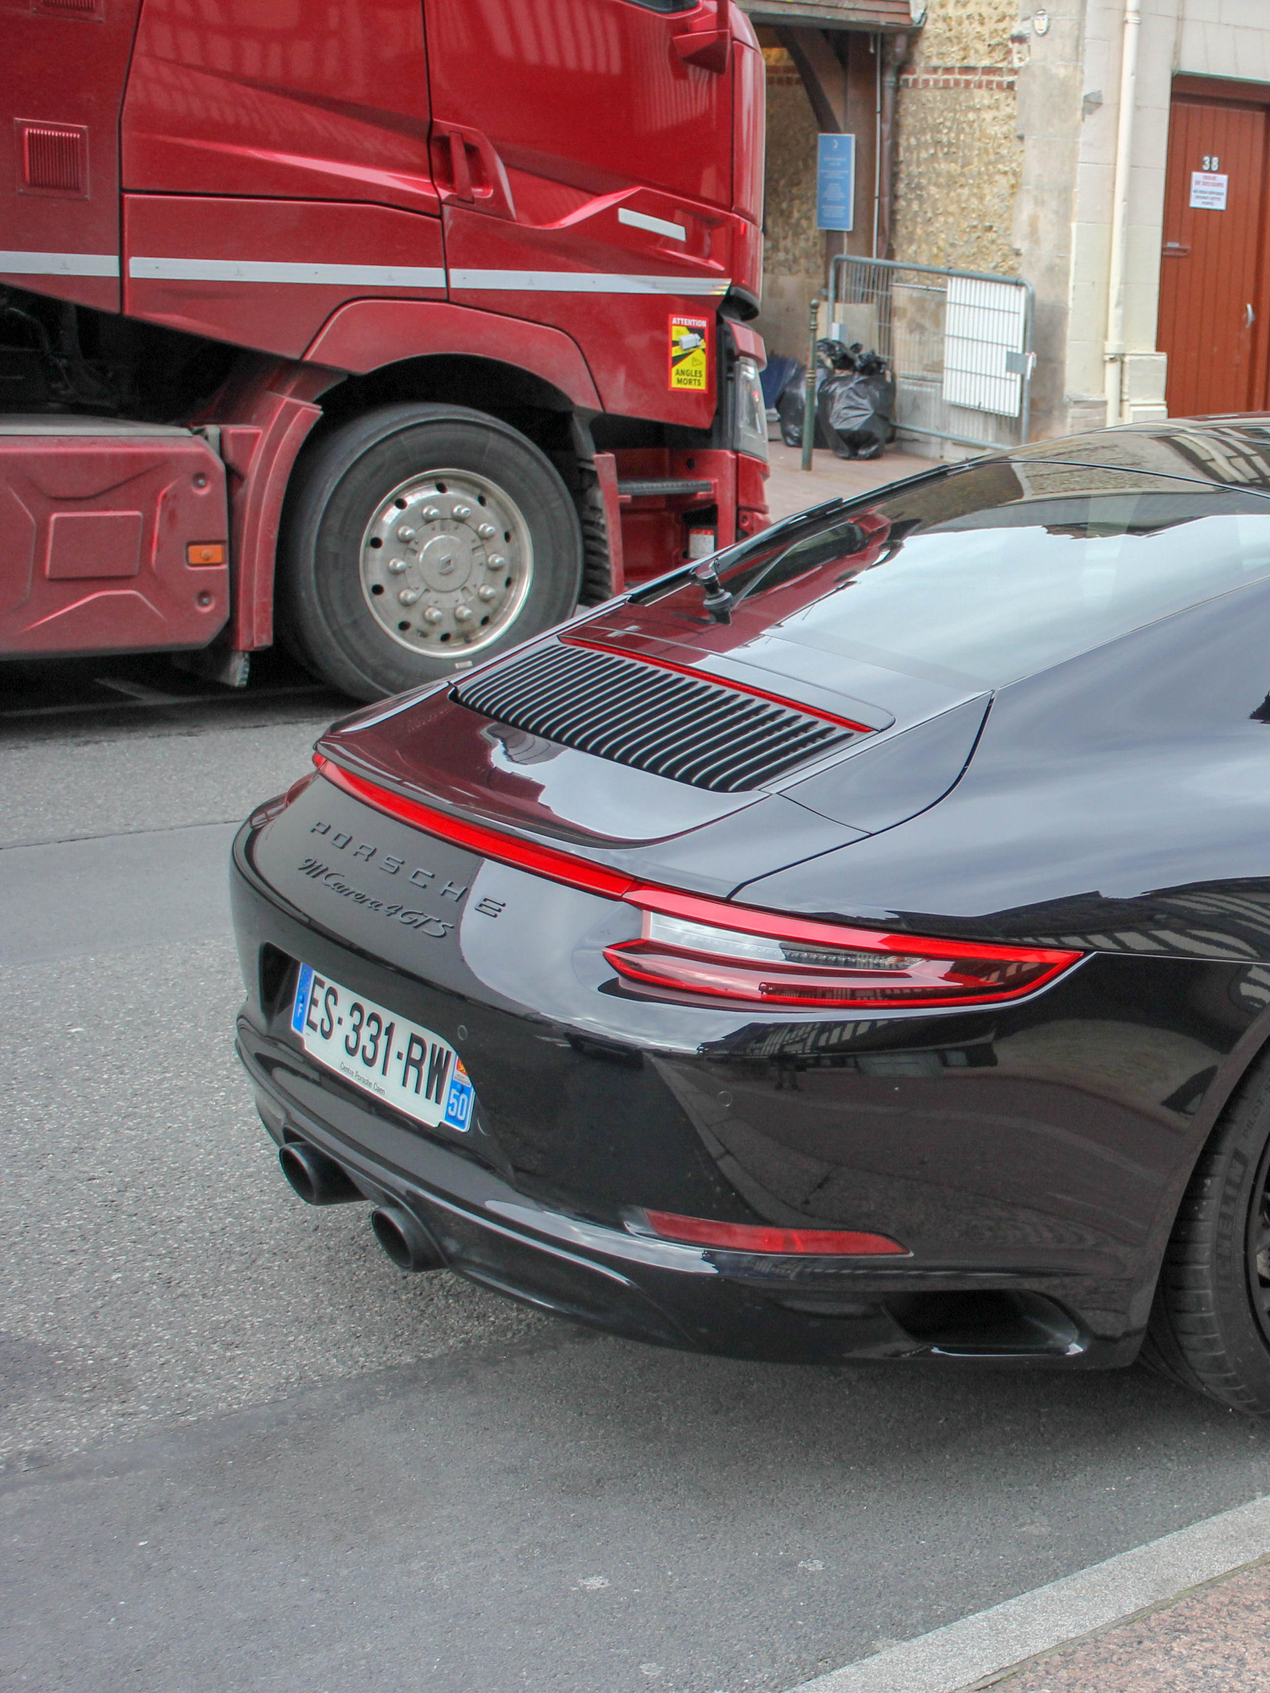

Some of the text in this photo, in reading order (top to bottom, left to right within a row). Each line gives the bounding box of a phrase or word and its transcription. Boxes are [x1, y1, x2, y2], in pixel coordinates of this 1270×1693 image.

[1202, 156, 1219, 171] 38
[672, 317, 707, 328] ATTENTION
[675, 369, 703, 378] ANGLES
[676, 378, 702, 386] MORTS
[309, 821, 507, 919] PORSCHE
[306, 975, 453, 1106] ES-331-RW
[340, 1061, 387, 1095] Centre Porsche Caen
[448, 1088, 469, 1121] 50
[1242, 1092, 1266, 1140] PILOT
